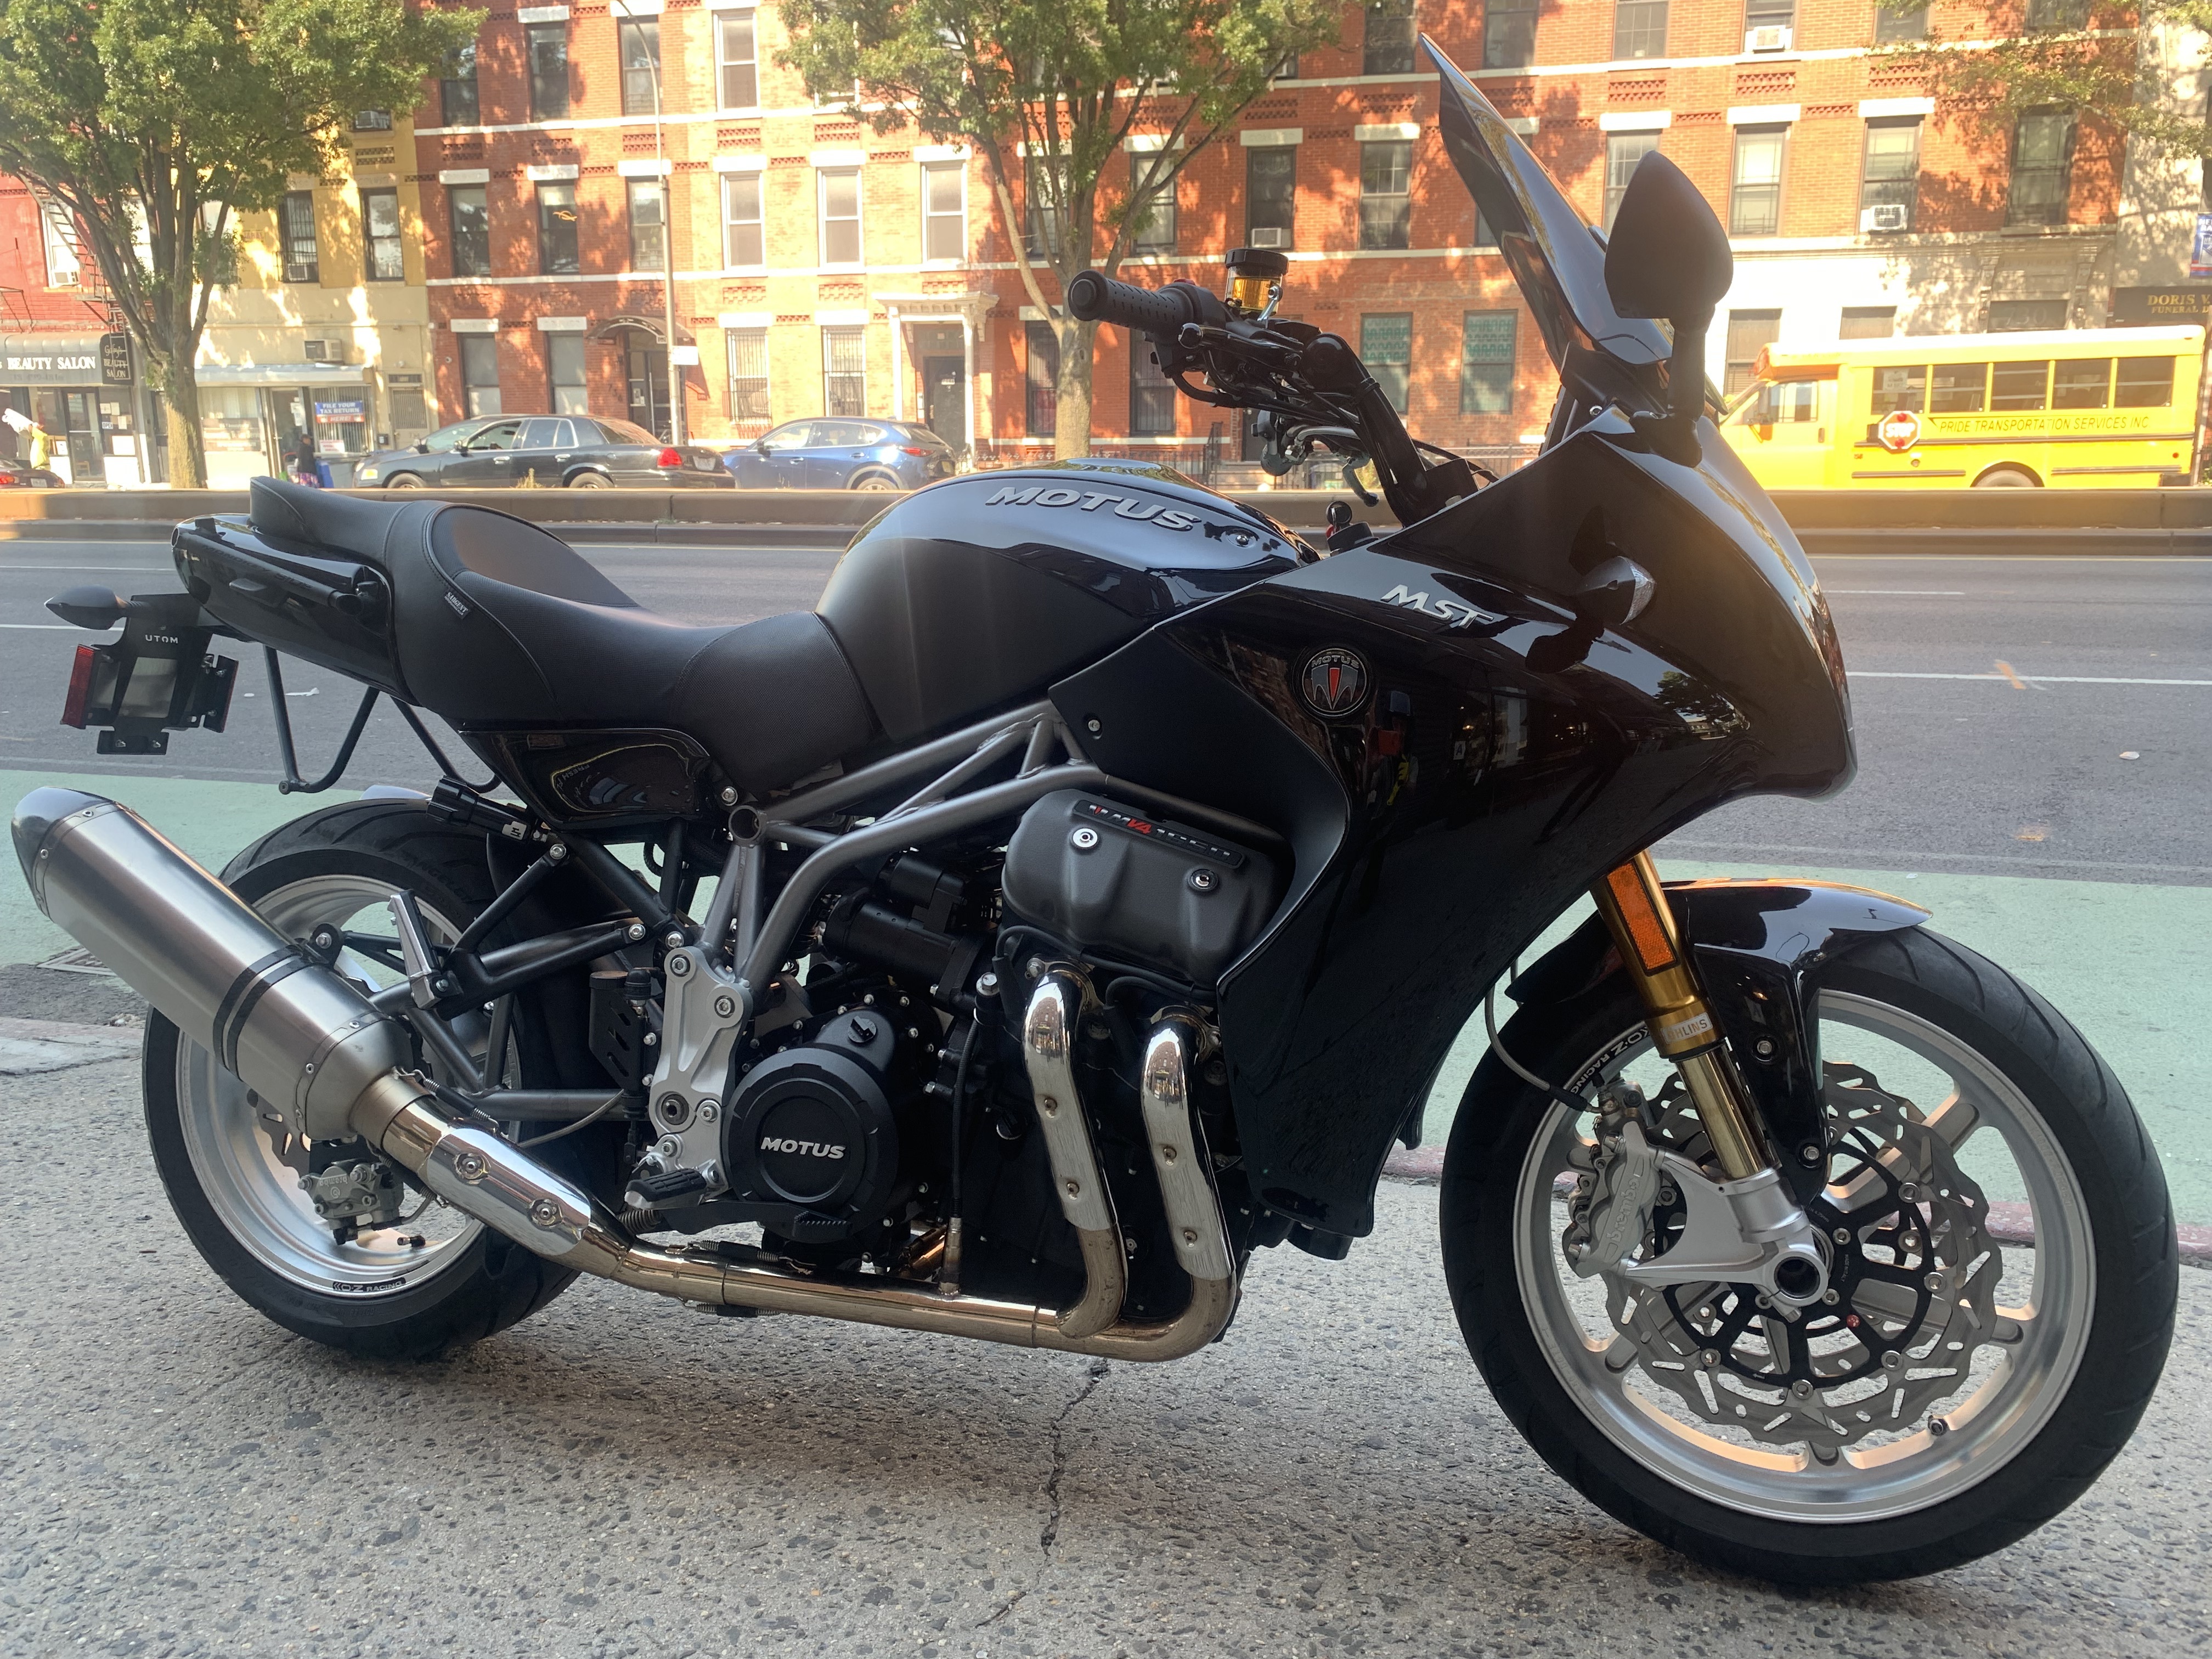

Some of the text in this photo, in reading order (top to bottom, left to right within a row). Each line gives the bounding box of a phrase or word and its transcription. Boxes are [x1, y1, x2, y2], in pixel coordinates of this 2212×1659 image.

[2147, 294, 2196, 306] DORIS
[2004, 306, 2047, 325] 730
[2151, 306, 2198, 314] FUNERAL
[7, 357, 52, 370] BEAUTY
[57, 357, 96, 370] SALON
[104, 358, 127, 368] BEAUTY
[106, 369, 126, 378] SAON
[1885, 422, 1916, 438] STOP
[1940, 421, 1971, 432] PRIDE
[1975, 417, 2070, 432] TRANSPORTATION
[2074, 416, 2127, 430] SERVICES
[985, 487, 1201, 532] MOTUS
[446, 592, 469, 613] SARGENT
[1380, 584, 1494, 629] MST
[145, 634, 178, 644] UTOM
[1311, 654, 1359, 669] MOTUS
[1570, 1053, 1610, 1094] RACING
[760, 1137, 846, 1160] MOTUS
[319, 1175, 348, 1188] brembo
[1605, 1177, 1640, 1243] brembo
[366, 1281, 403, 1292] RACING
